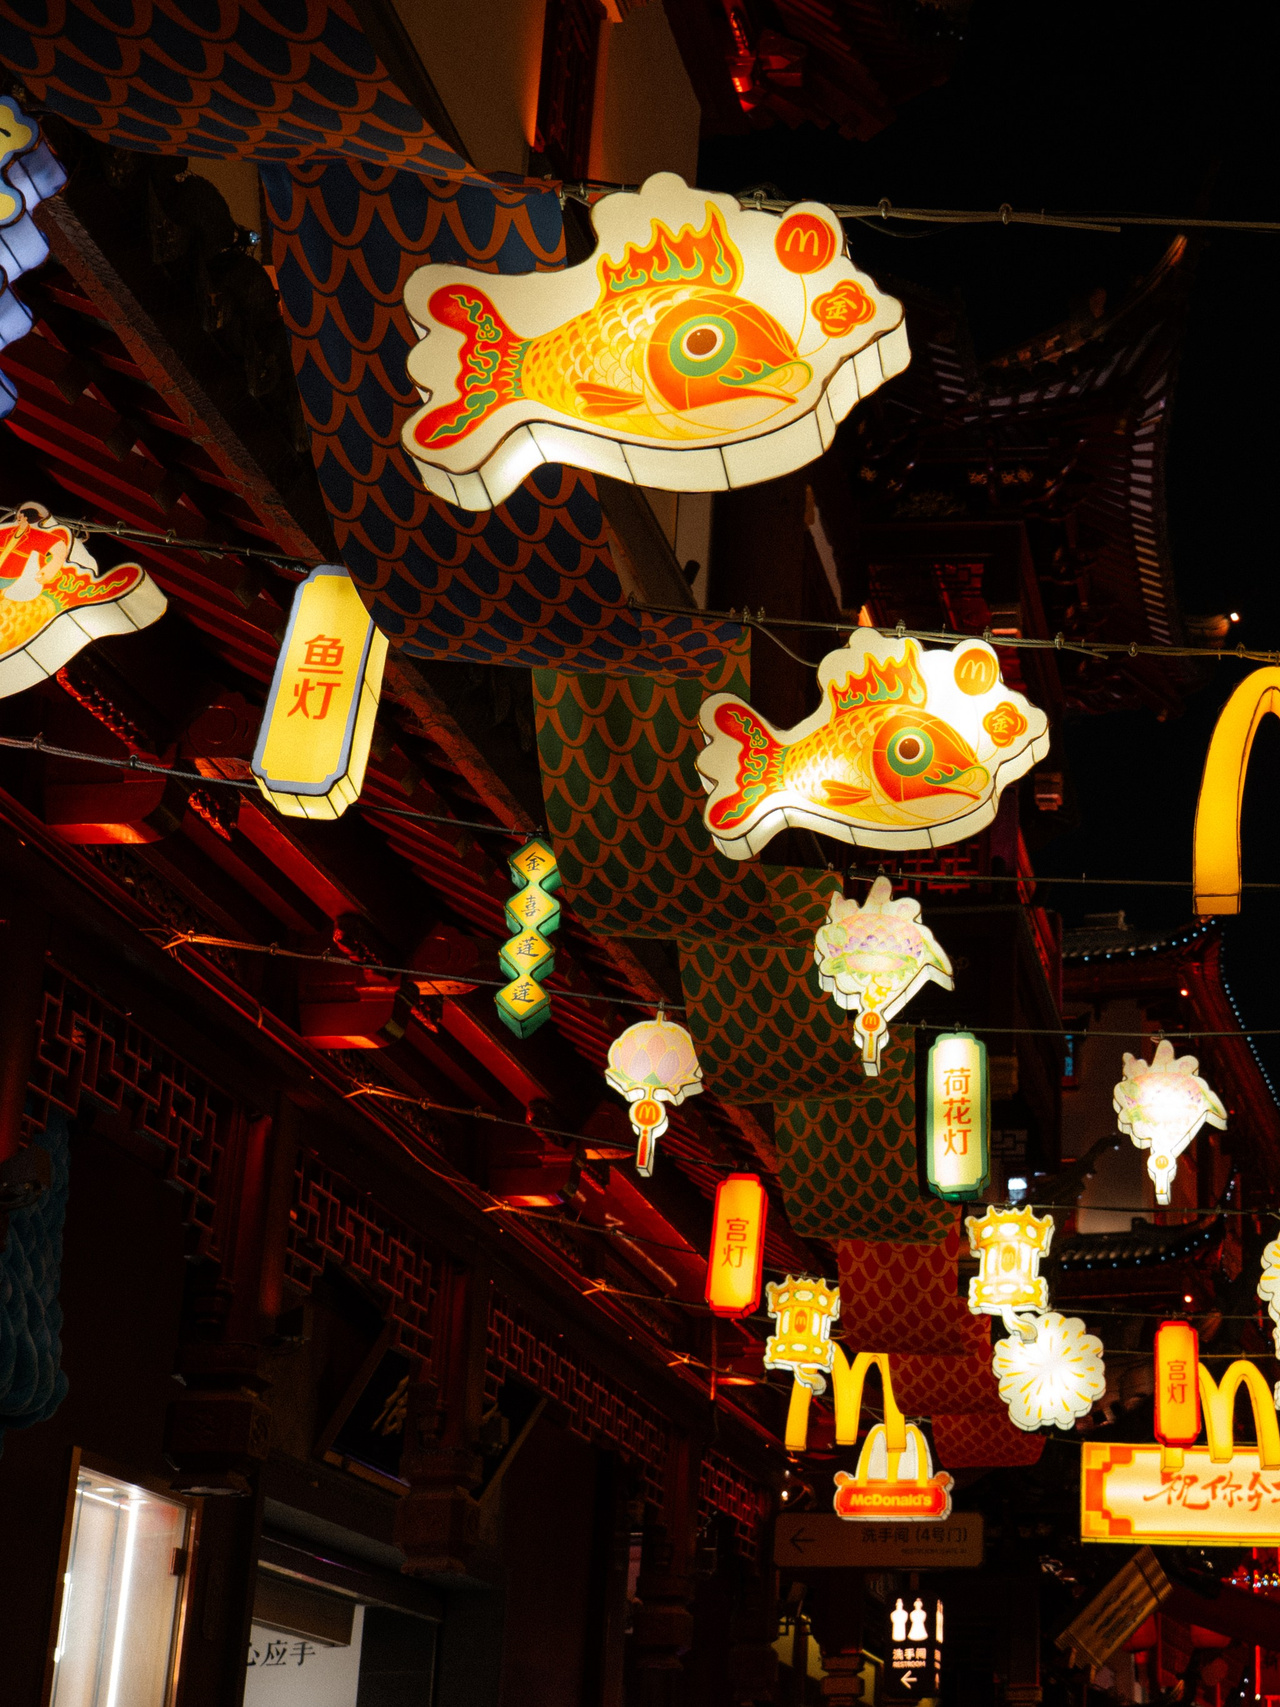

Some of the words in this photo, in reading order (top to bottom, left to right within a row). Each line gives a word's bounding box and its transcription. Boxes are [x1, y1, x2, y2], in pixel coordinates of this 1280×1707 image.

[826, 292, 857, 320] 金
[287, 634, 345, 720] 鱼灯
[991, 711, 1015, 734] 金
[943, 1066, 972, 1156] 荷花灯
[721, 1217, 749, 1268] 宫灯
[1167, 1359, 1188, 1405] 宫灯
[850, 1494, 932, 1507] McDonald's
[861, 1527, 909, 1543] 洗手间
